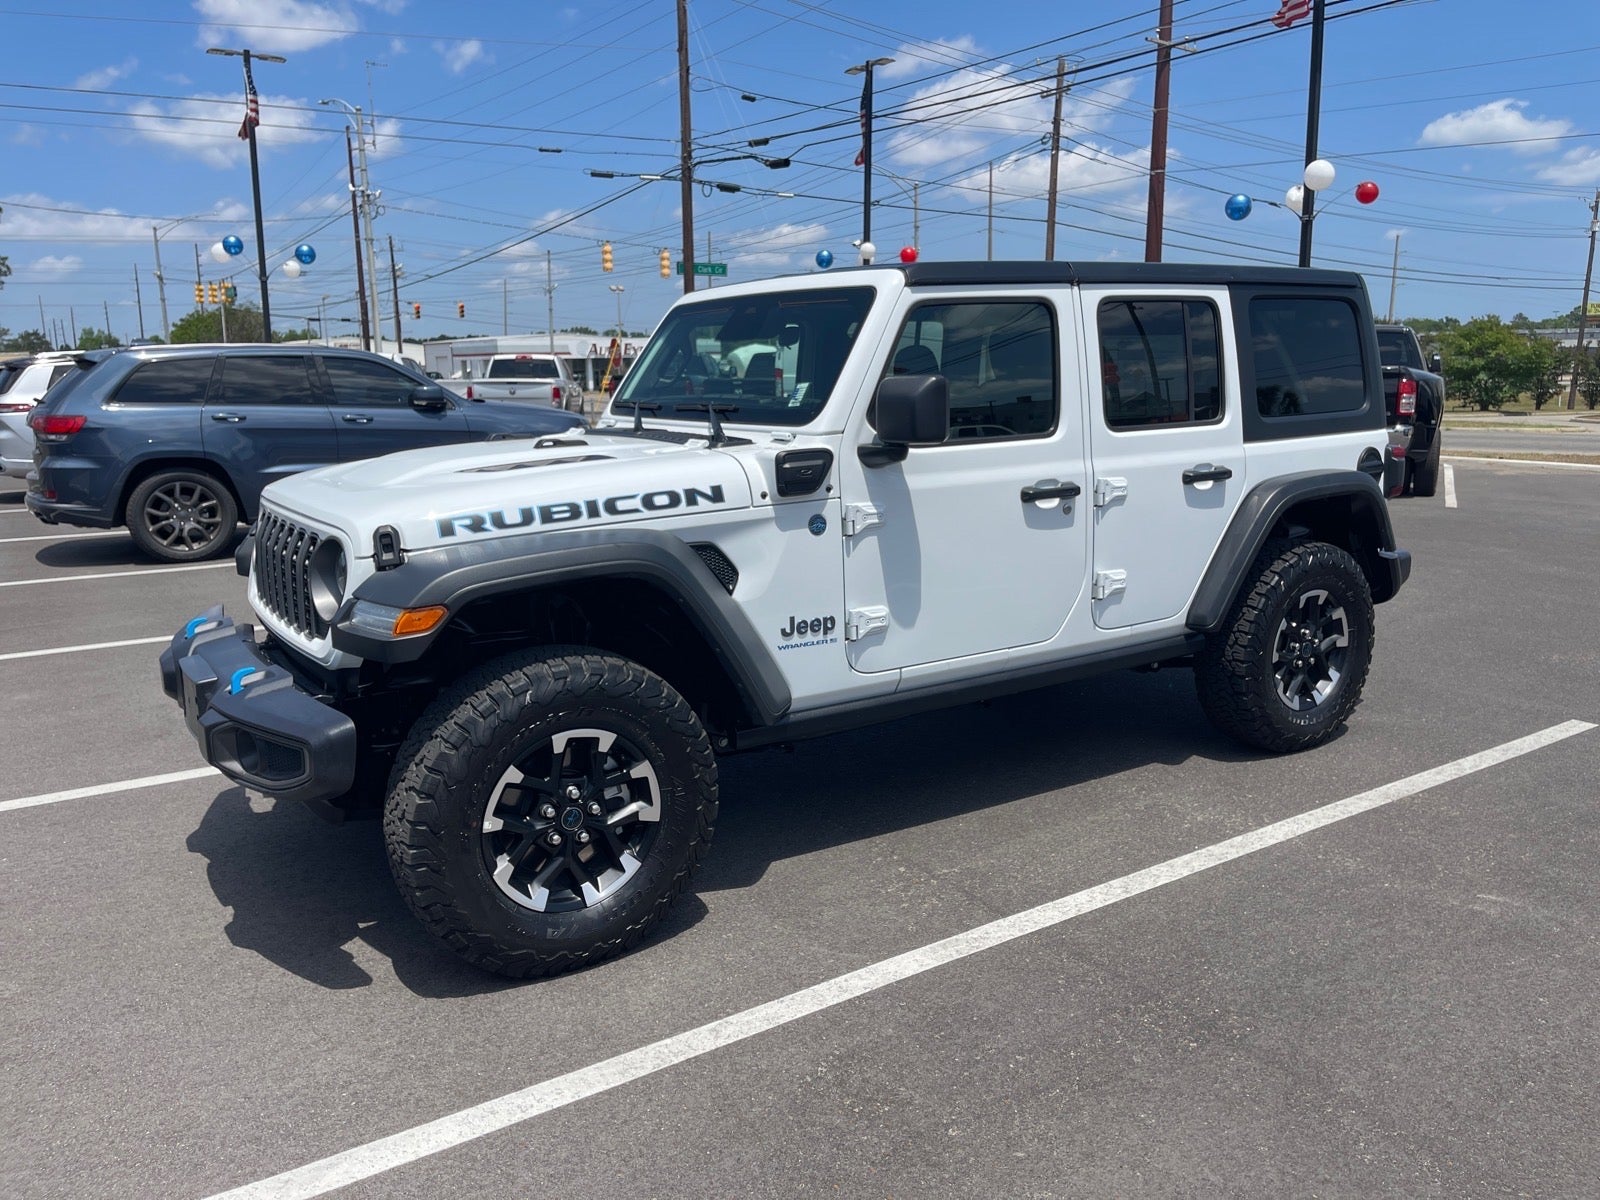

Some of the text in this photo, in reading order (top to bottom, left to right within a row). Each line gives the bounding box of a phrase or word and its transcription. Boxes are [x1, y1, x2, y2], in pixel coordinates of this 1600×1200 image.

[435, 484, 726, 538] RUBICON
[780, 615, 836, 638] Jeep
[777, 639, 828, 651] WRANGLER
